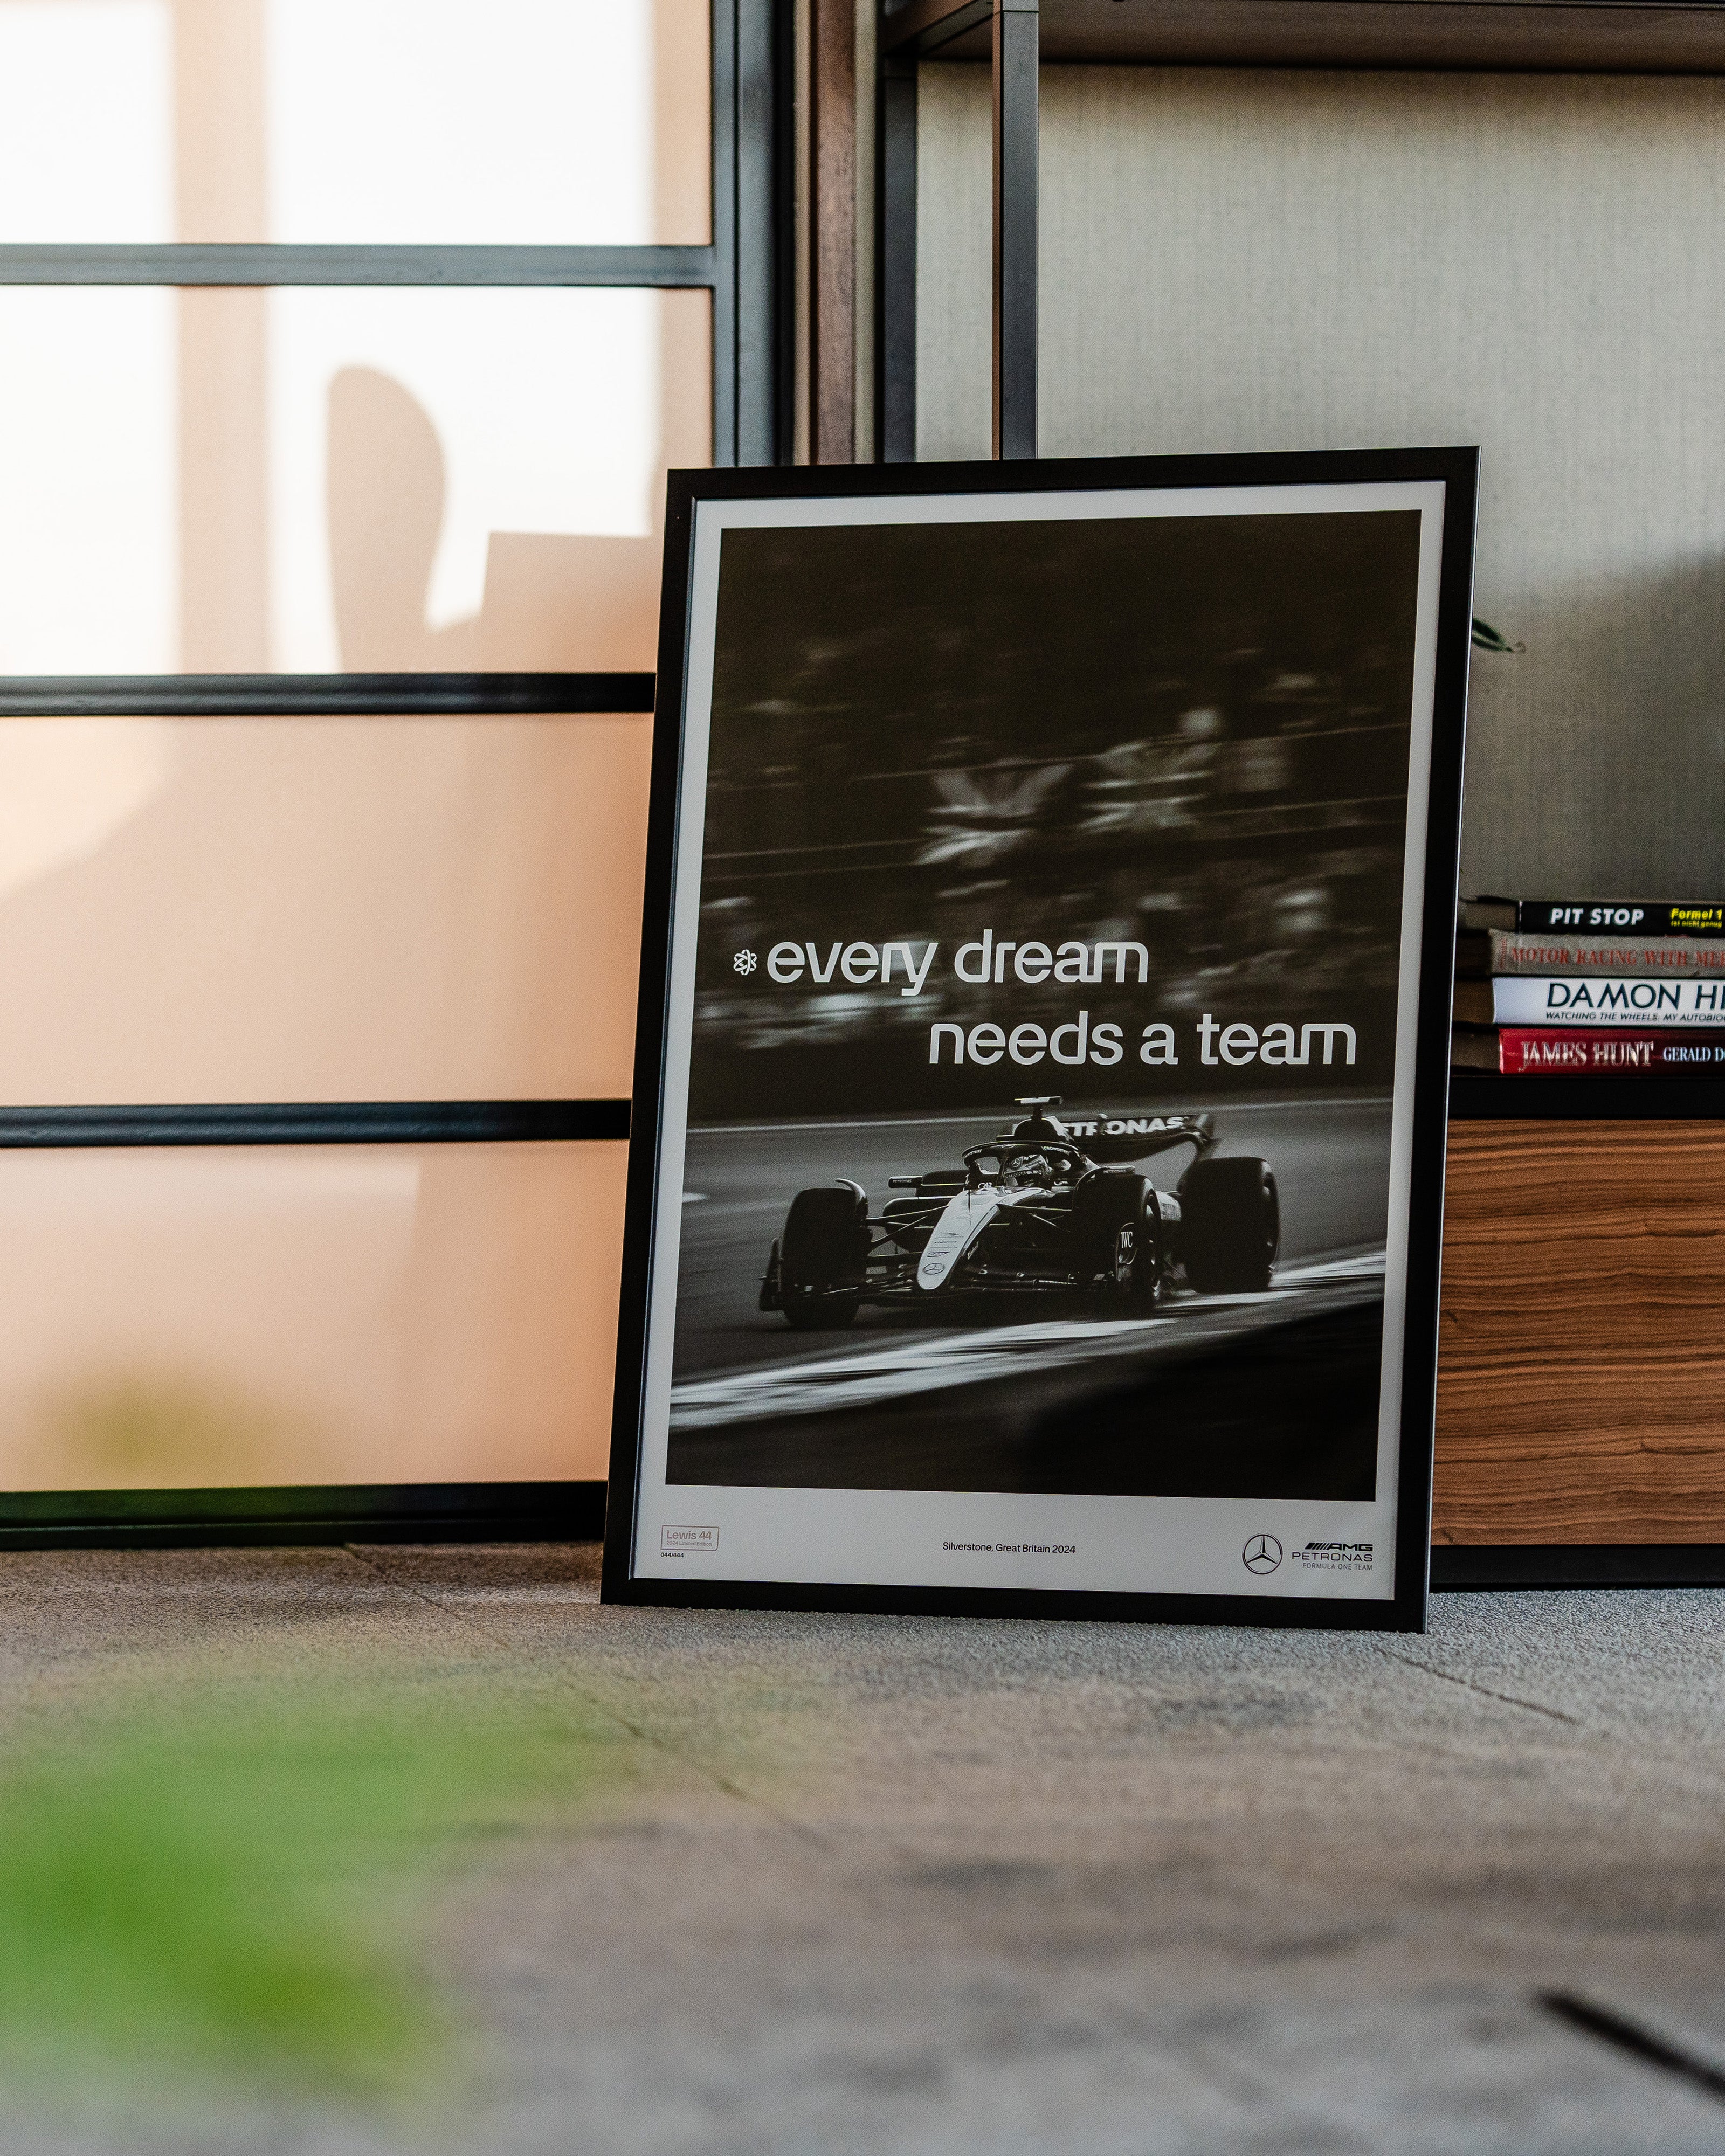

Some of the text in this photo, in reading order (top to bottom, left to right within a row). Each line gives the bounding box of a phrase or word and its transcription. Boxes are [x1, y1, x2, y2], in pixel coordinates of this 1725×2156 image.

[1550, 908, 1644, 925] PIT STOP
[1671, 908, 1722, 920] Formel 1
[767, 929, 1149, 997] every dream
[1512, 947, 1569, 964] MOTOR
[1576, 949, 1637, 966] RACING
[1644, 950, 1688, 967] WITH
[1547, 982, 1681, 1010] DAMON
[1545, 1011, 1596, 1021] WATCHING
[1599, 1012, 1617, 1021] THE
[1663, 1013, 1678, 1021] MY
[1679, 1013, 1725, 1022] AUTOBIO
[929, 1010, 1356, 1065] needs a team
[1518, 1041, 1654, 1072] JAMES HUNT
[1663, 1046, 1725, 1062] GERALD D
[1120, 1231, 1133, 1248] IWC
[666, 1530, 712, 1540] Lewis 44
[943, 1542, 1076, 1553] Silverstone, Great Britain 2024
[1327, 1543, 1373, 1552] AMG
[1292, 1552, 1373, 1562] PETRONAS
